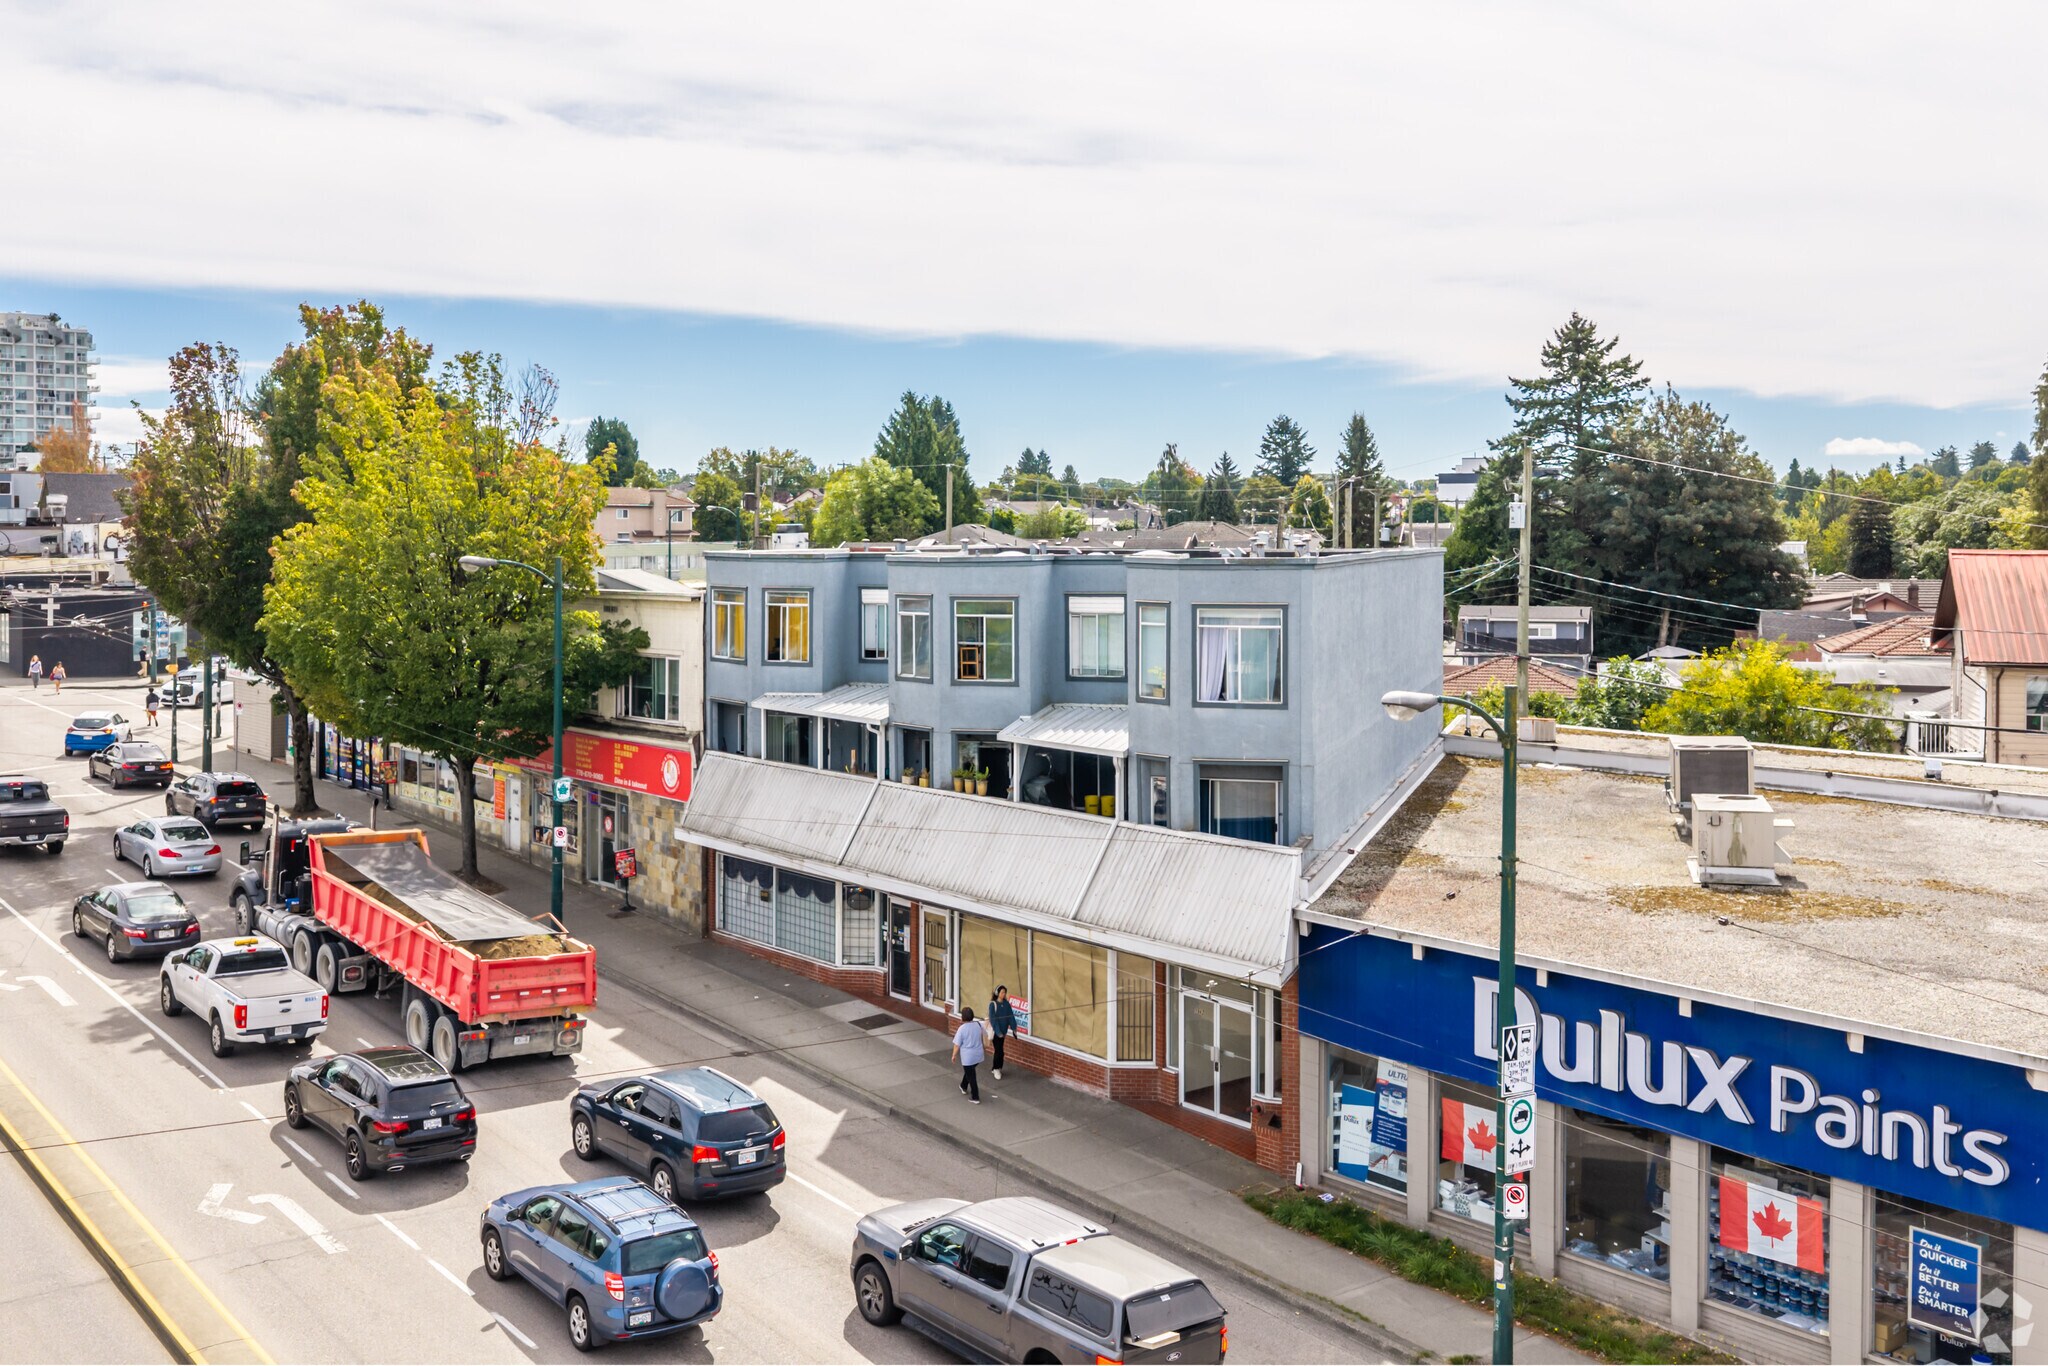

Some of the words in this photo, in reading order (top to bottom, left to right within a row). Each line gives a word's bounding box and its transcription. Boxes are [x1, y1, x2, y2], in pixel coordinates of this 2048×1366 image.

[1009, 997, 1020, 1008] FOR
[1472, 976, 1755, 1125] Dulux
[1770, 1064, 2010, 1187] Paints
[1343, 1114, 1359, 1125] Dulux
[1919, 1238, 1933, 1250] Do
[1933, 1243, 1942, 1252] it
[1919, 1248, 1968, 1271] QUICKER
[1918, 1262, 1932, 1274] Do
[1933, 1268, 1941, 1277] it
[1918, 1271, 1960, 1293] BETTER
[1918, 1286, 1932, 1297] Do
[1932, 1291, 1941, 1300] it
[1918, 1295, 1969, 1319] SMARTER
[1940, 1333, 1964, 1348] Dulux
